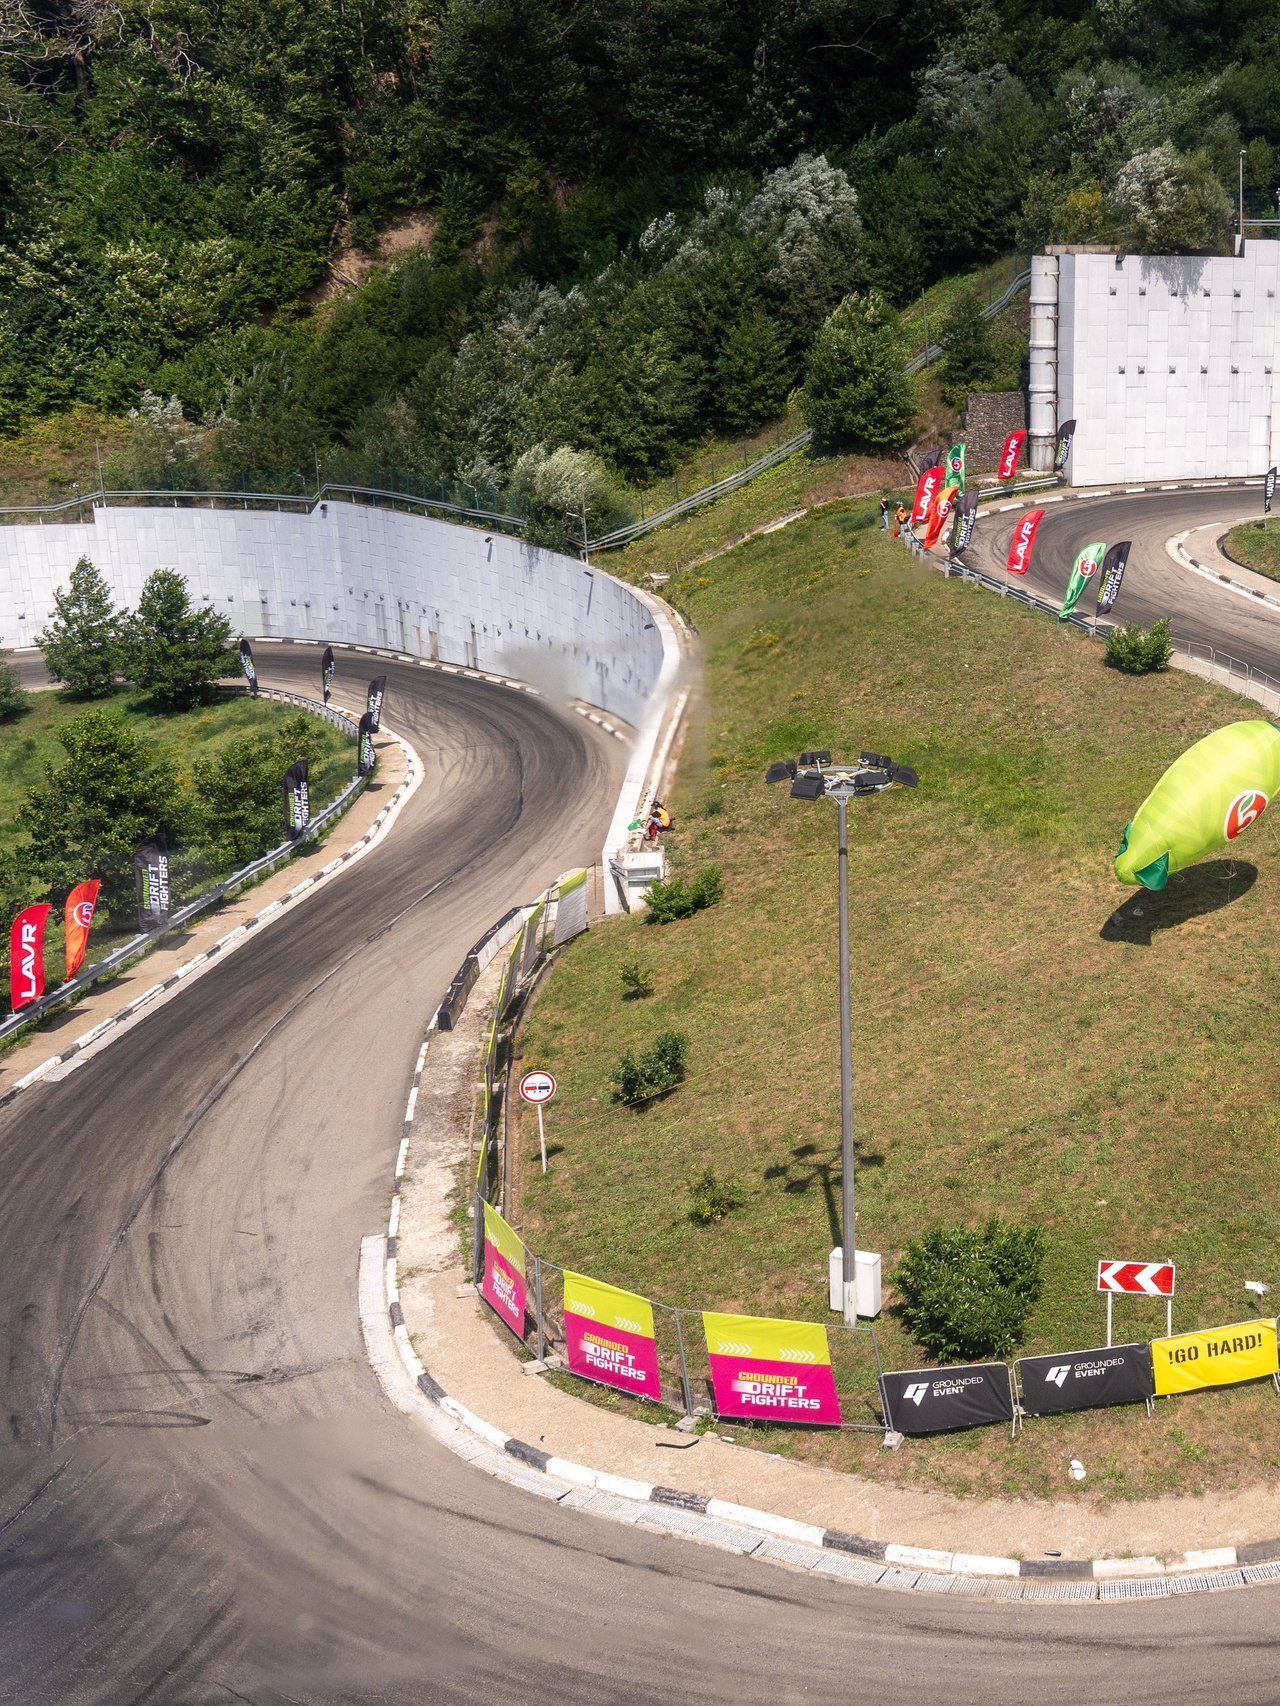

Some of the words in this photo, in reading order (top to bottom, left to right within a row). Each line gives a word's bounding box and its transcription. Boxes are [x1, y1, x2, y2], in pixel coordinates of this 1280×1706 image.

[1002, 438, 1019, 477] LAVR
[916, 476, 937, 520] LAVR
[1266, 474, 1275, 498] HARD!
[959, 513, 970, 545] DRIFT
[963, 508, 976, 548] FIGHTERS
[1012, 521, 1035, 570] LAVR
[1102, 566, 1117, 600] DRIFT
[1108, 561, 1125, 605] FIGHTERS
[373, 691, 383, 726] FIGHTERS
[363, 731, 371, 760] DRIFT
[294, 787, 302, 821] DRIFT
[300, 781, 310, 827] FIGHTERS
[148, 863, 160, 905] DRIFT
[158, 855, 169, 911] FIGHTERS
[21, 923, 37, 998] LAVR
[492, 1280, 519, 1318] FIGHTERS
[496, 1273, 517, 1301] DRIFT
[583, 1332, 629, 1353] GROUNDED
[590, 1343, 636, 1367] DRIFT
[1168, 1340, 1199, 1365] !GO
[1206, 1333, 1262, 1358] HARD!
[585, 1352, 646, 1381] FIGHTERS
[738, 1371, 798, 1386] GROUNDED
[1073, 1357, 1125, 1371] GROUNDED
[1075, 1367, 1107, 1379] EVENT
[750, 1381, 807, 1398] DRIFT
[931, 1376, 984, 1389] GROUNDED
[933, 1385, 965, 1397] EVENT
[741, 1393, 821, 1410] FIGHTERS
